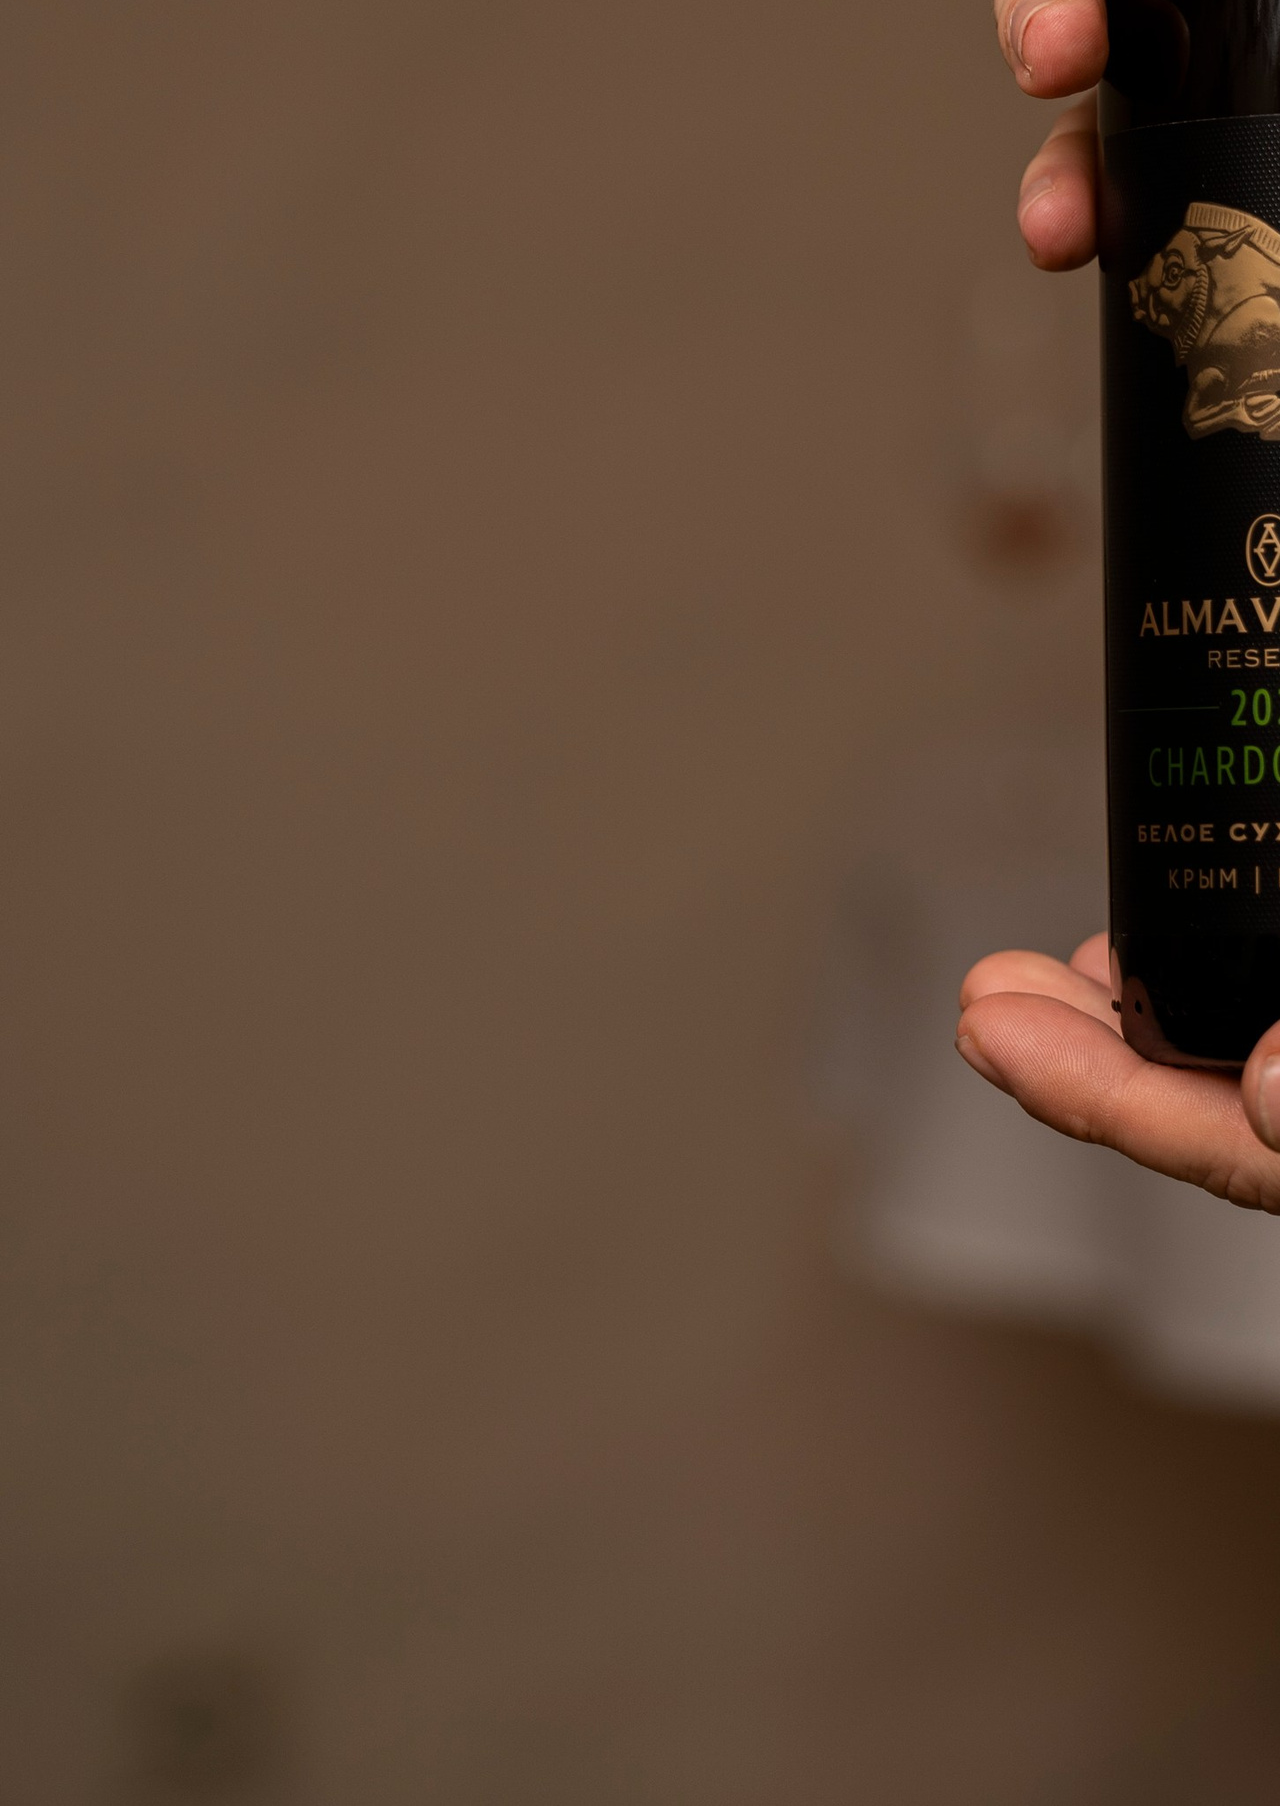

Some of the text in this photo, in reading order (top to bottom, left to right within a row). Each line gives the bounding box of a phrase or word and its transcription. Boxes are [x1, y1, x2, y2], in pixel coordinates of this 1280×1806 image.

[1139, 597, 1248, 638] ALMA
[1137, 822, 1215, 844] БЕЛОЕ
[1168, 865, 1239, 891] КРЫМ
